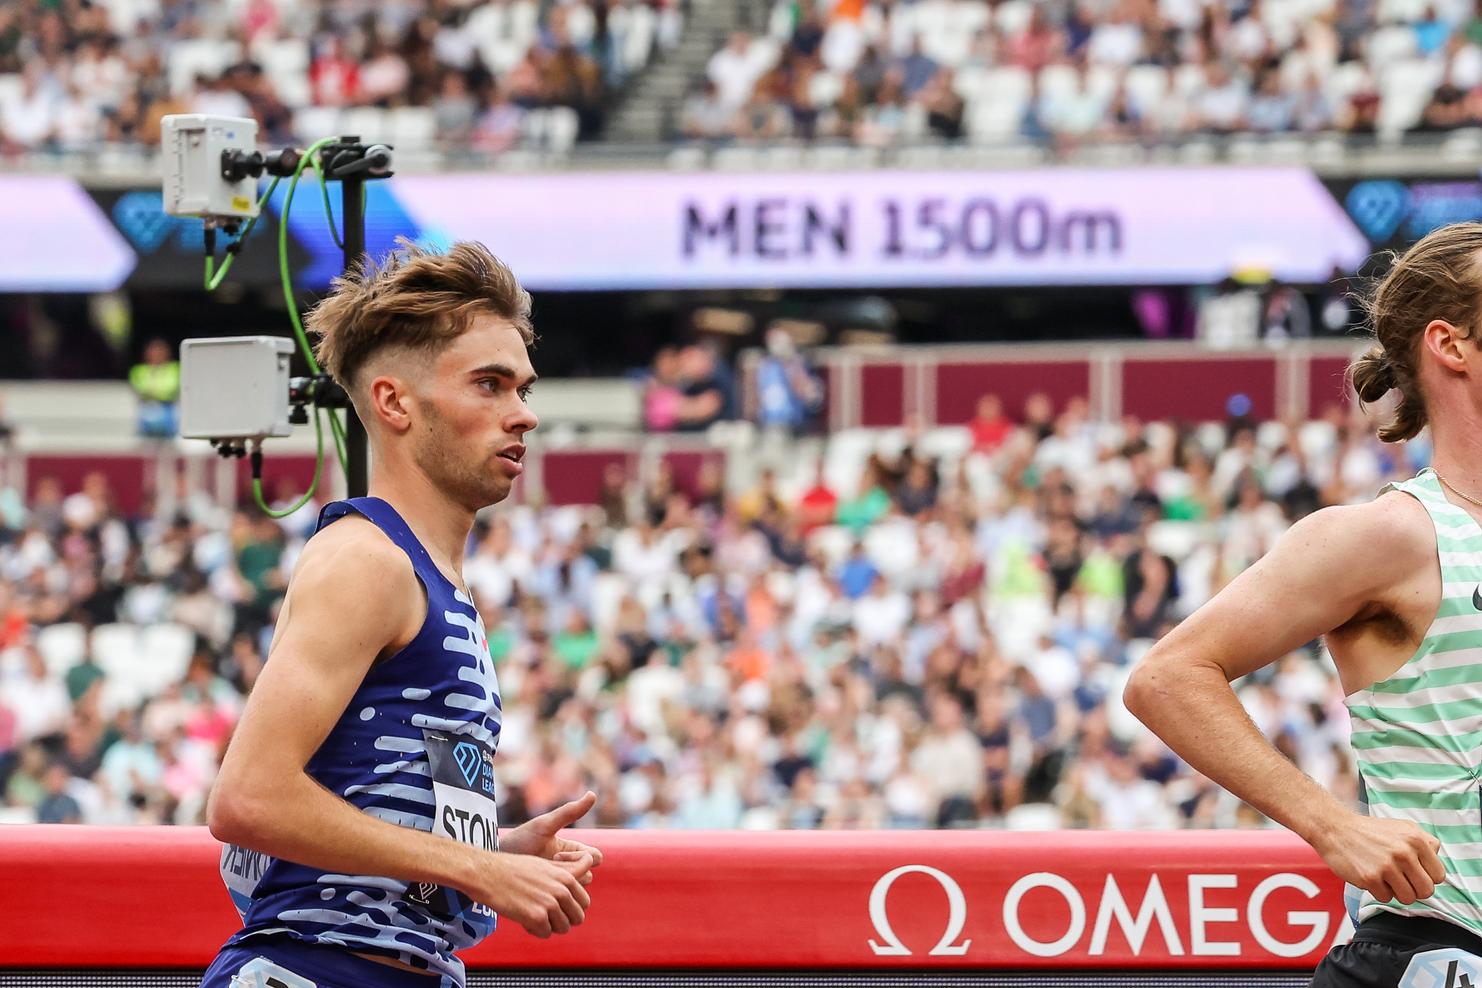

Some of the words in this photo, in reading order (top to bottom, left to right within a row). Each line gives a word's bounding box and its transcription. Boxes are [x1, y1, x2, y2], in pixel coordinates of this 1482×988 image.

[683, 200, 849, 258] MEN
[880, 198, 1122, 259] 1500m
[442, 804, 499, 852] STON
[1002, 872, 1355, 958] OMEG
